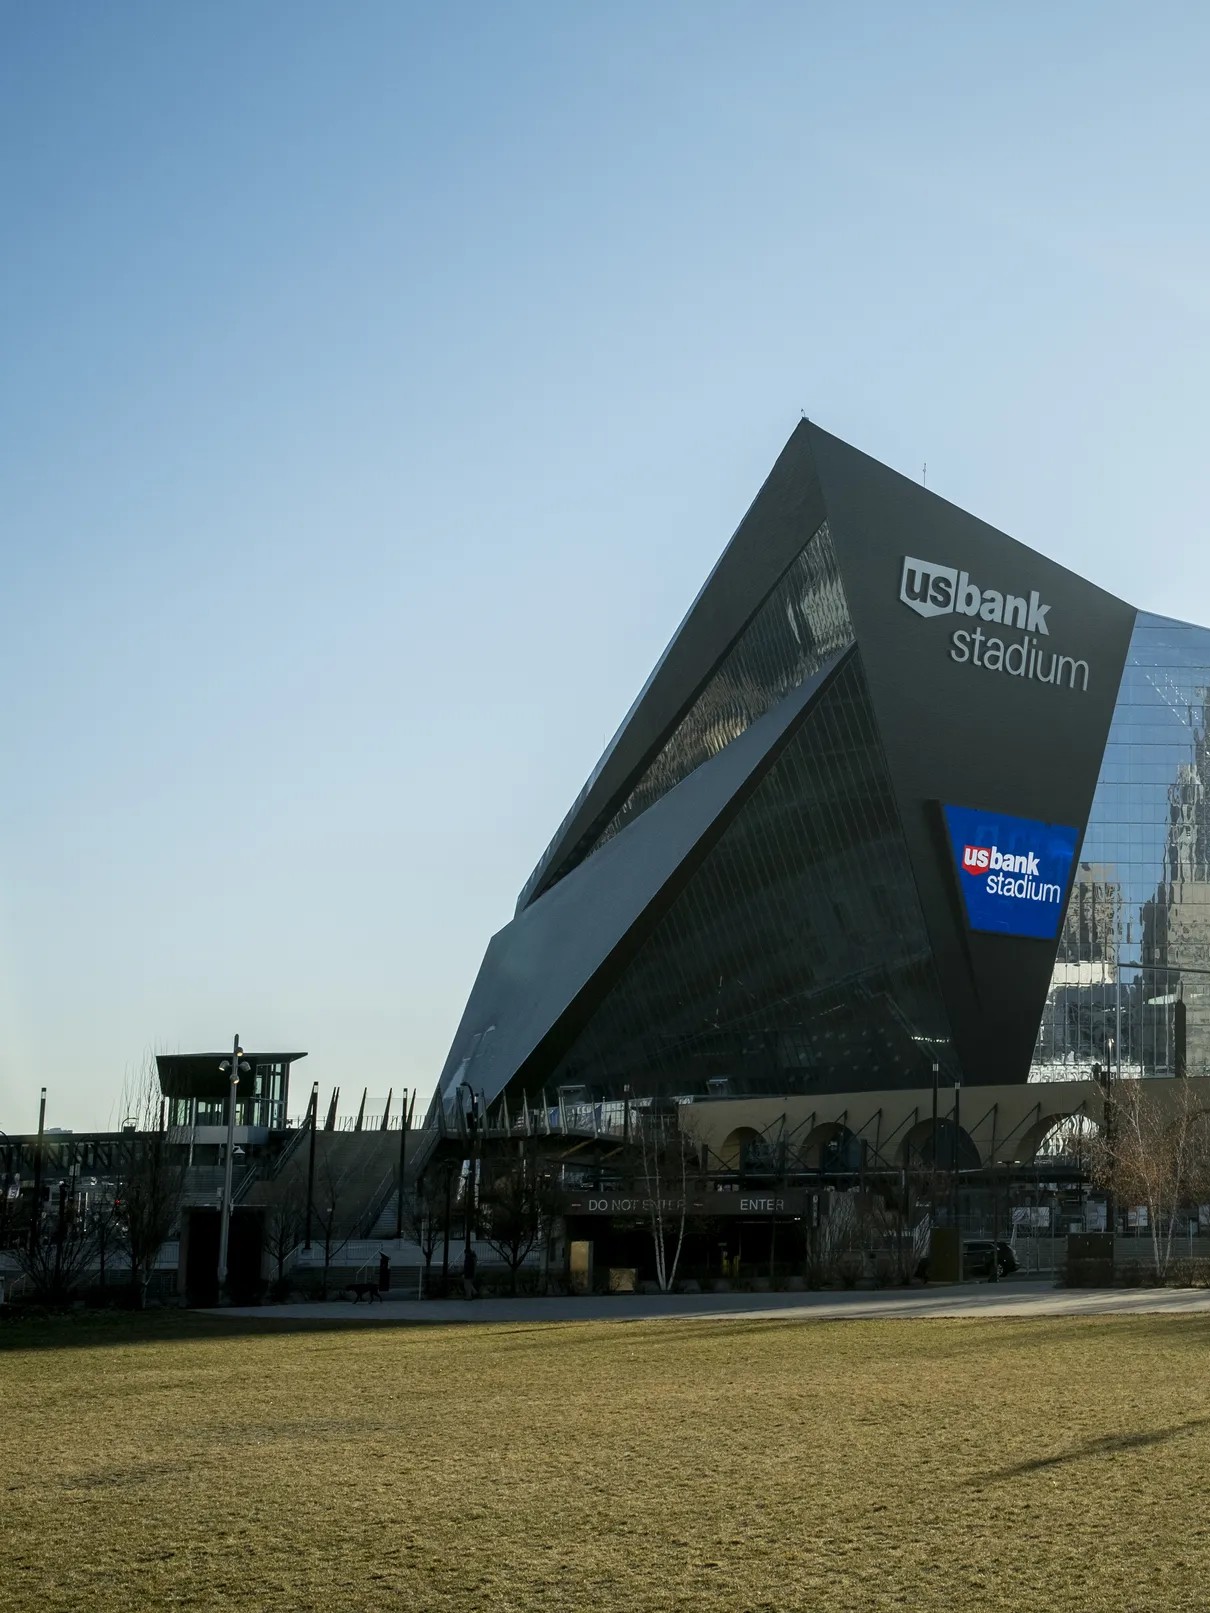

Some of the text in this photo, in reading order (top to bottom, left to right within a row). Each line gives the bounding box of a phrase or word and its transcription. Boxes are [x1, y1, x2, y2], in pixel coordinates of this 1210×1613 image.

[950, 626, 1090, 692] stadium
[986, 872, 1061, 904] stadium
[588, 1199, 609, 1211] DO
[611, 1199, 639, 1211] NOT
[740, 1199, 785, 1211] ENTER
